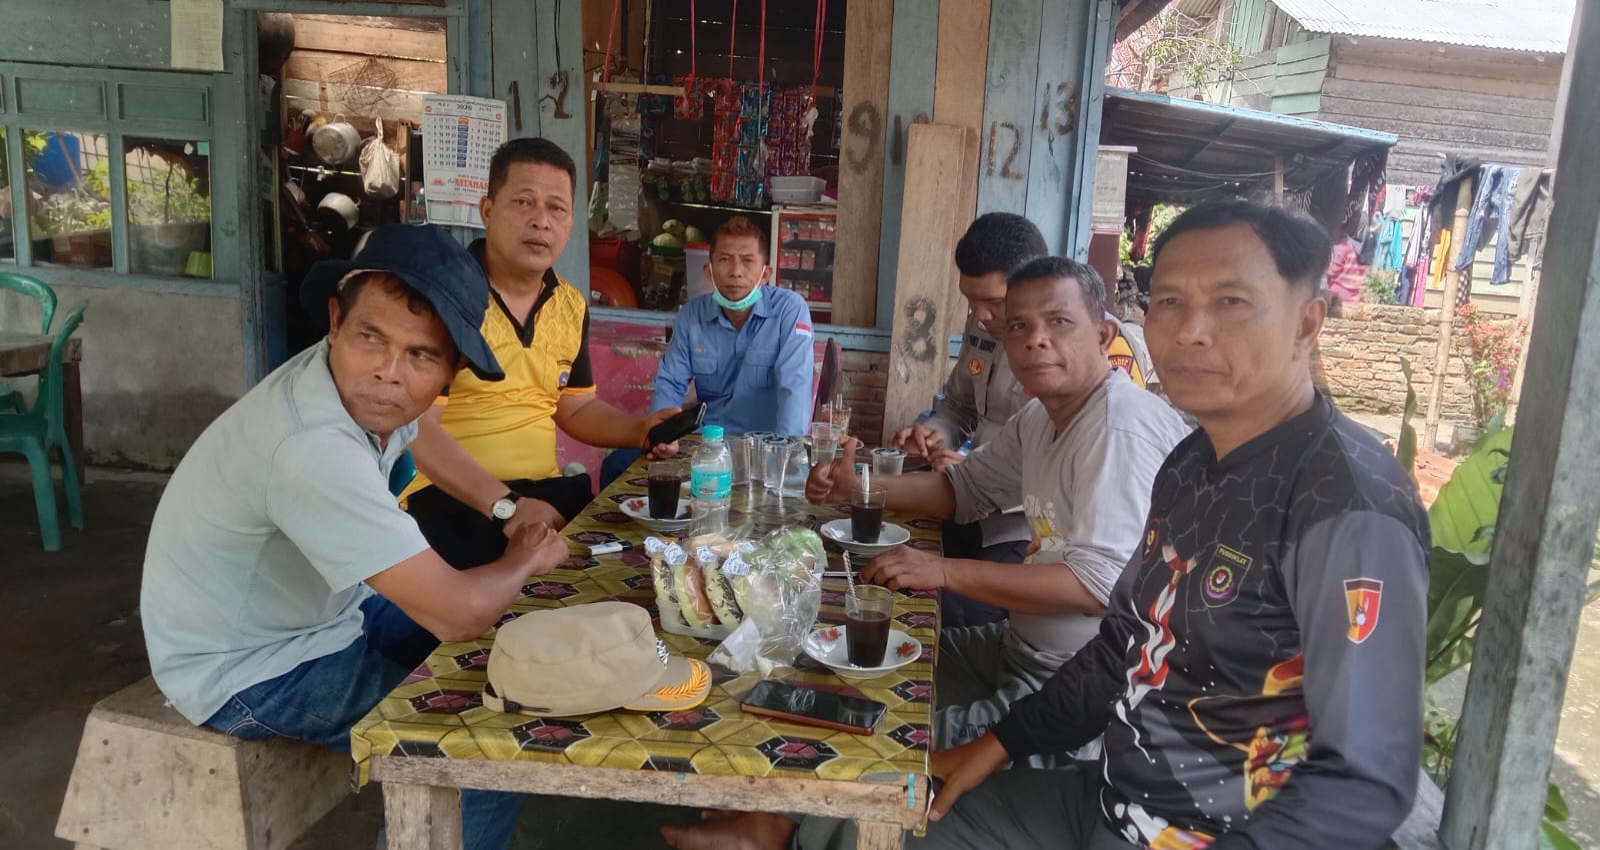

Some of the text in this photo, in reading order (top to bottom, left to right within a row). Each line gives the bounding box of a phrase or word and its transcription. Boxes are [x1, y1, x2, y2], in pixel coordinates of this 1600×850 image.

[845, 100, 881, 175] 9
[986, 120, 1025, 182] 12
[904, 294, 938, 362] 8
